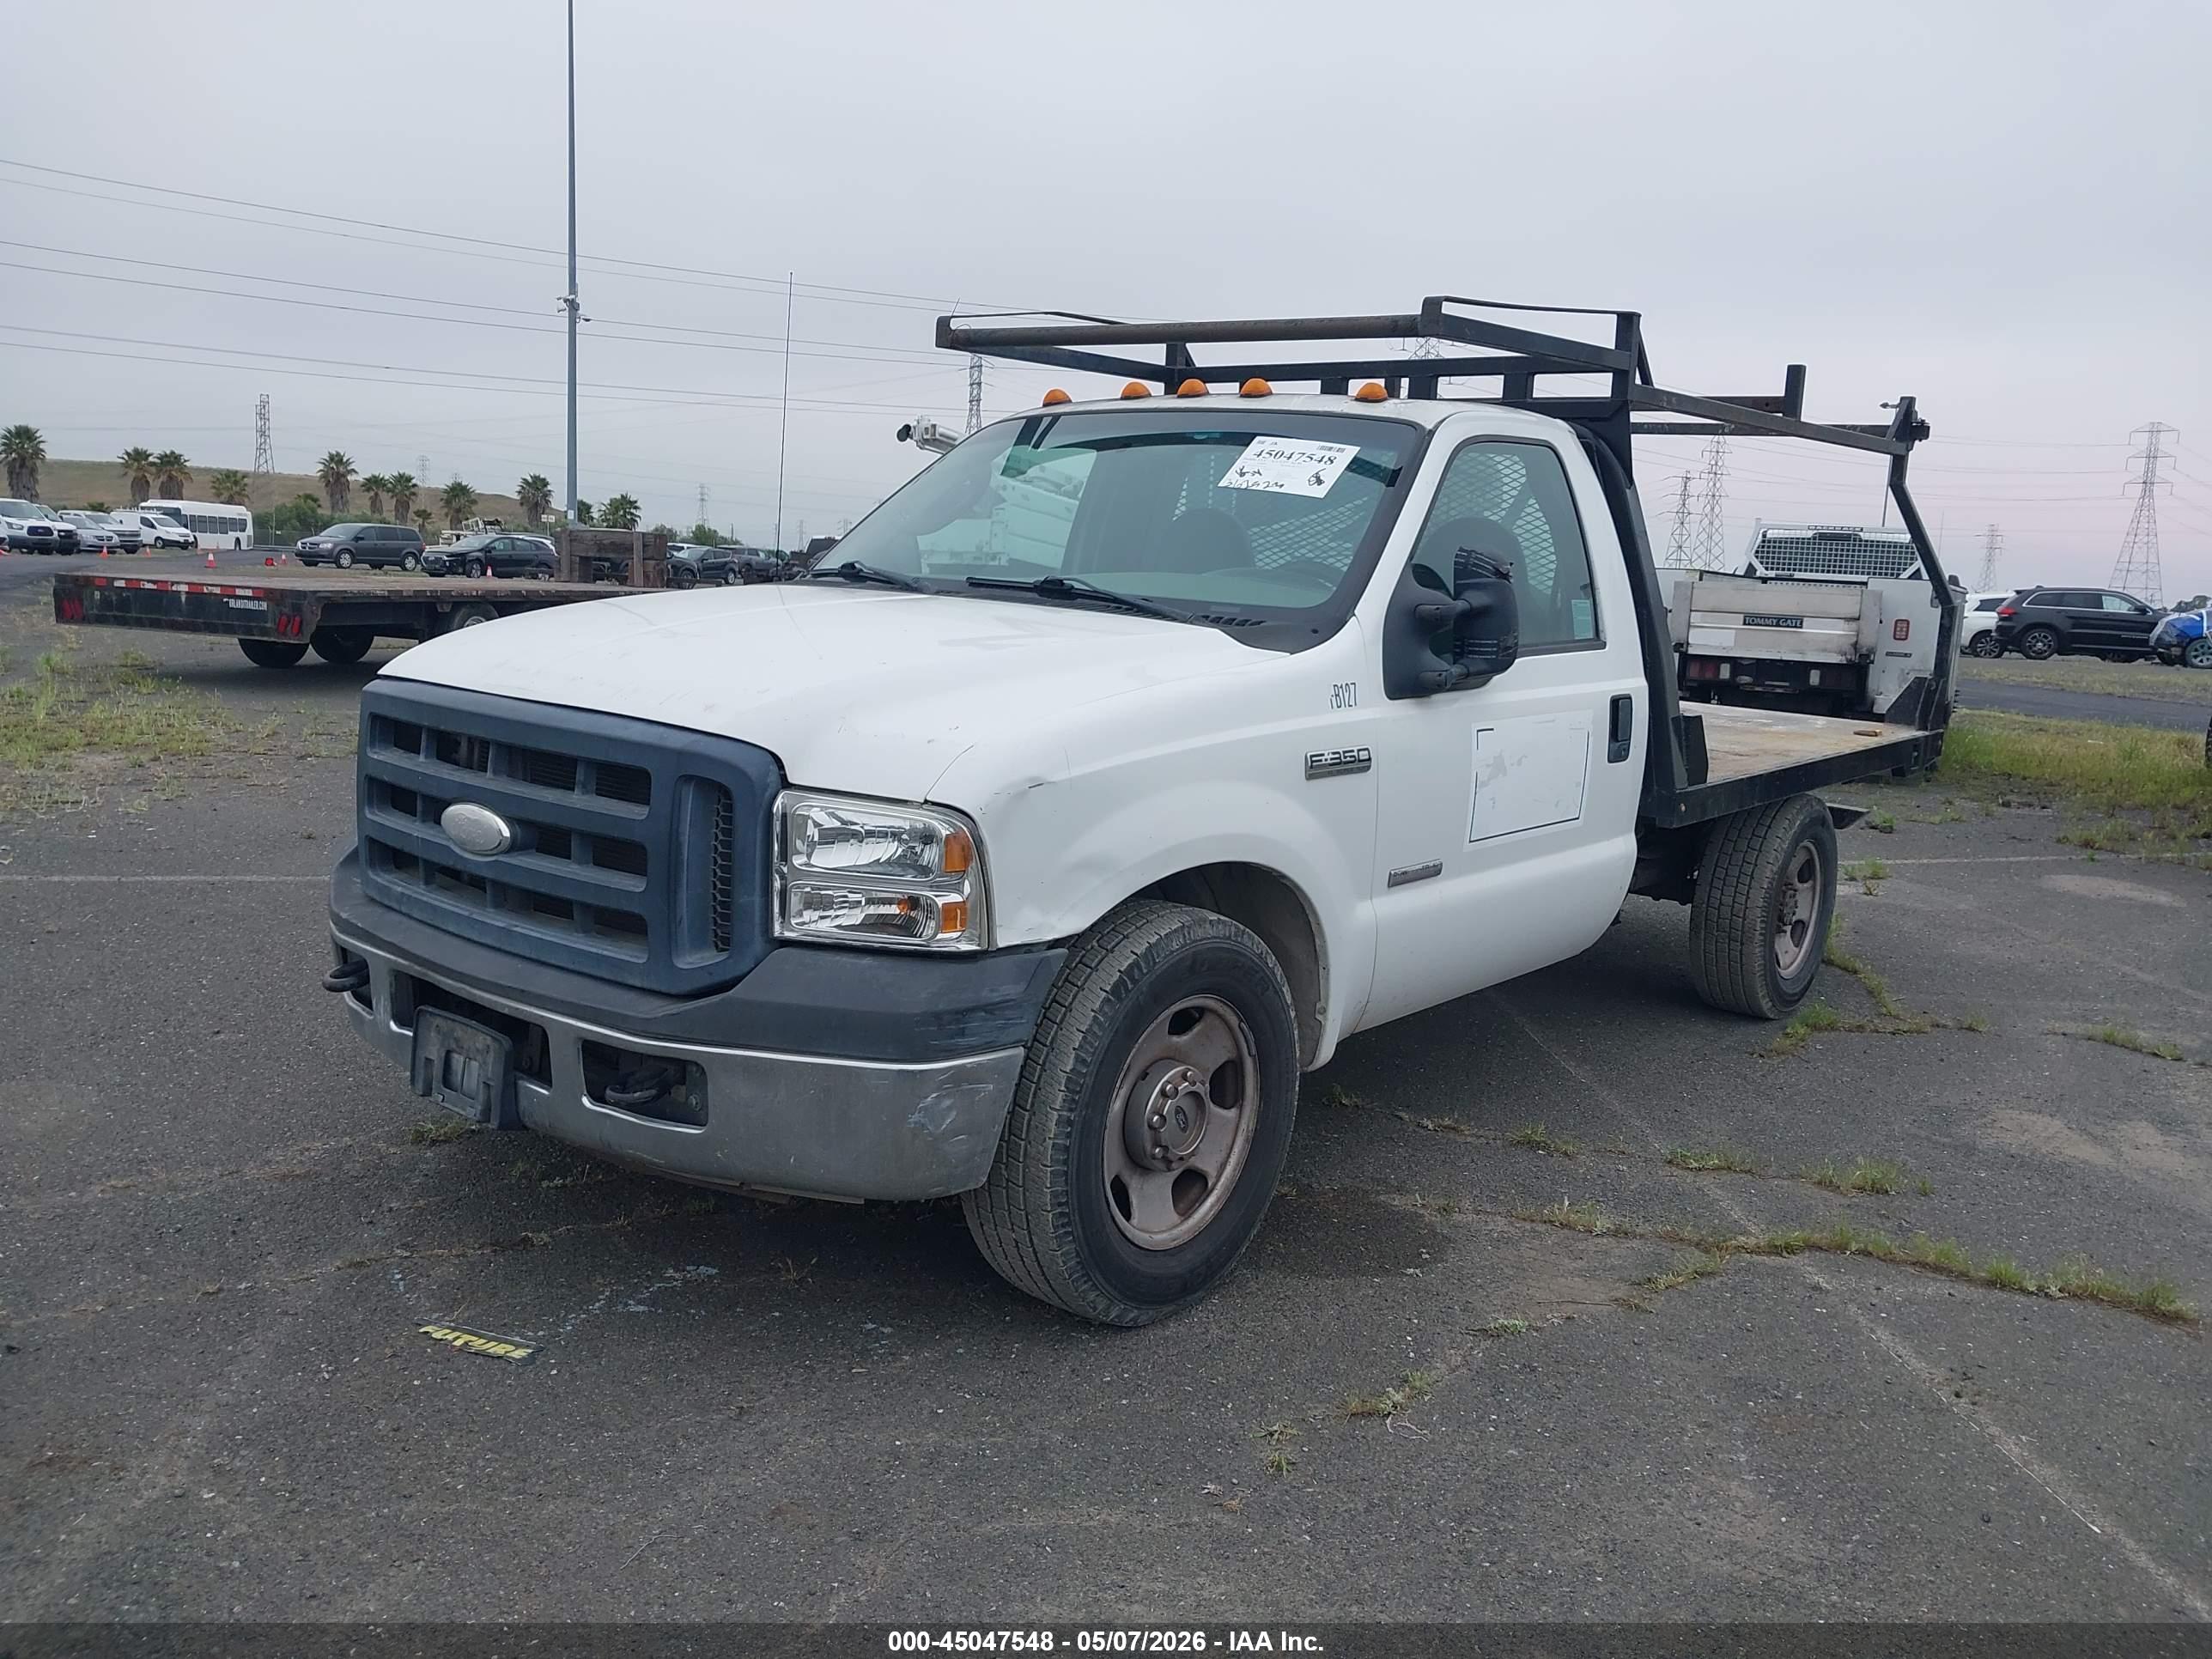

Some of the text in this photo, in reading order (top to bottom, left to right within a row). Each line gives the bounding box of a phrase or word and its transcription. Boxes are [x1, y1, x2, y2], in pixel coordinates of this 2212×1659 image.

[1253, 448, 1338, 466] 45047548
[1744, 617, 1802, 628] TOMMY GATE
[1309, 747, 1371, 769] F-350
